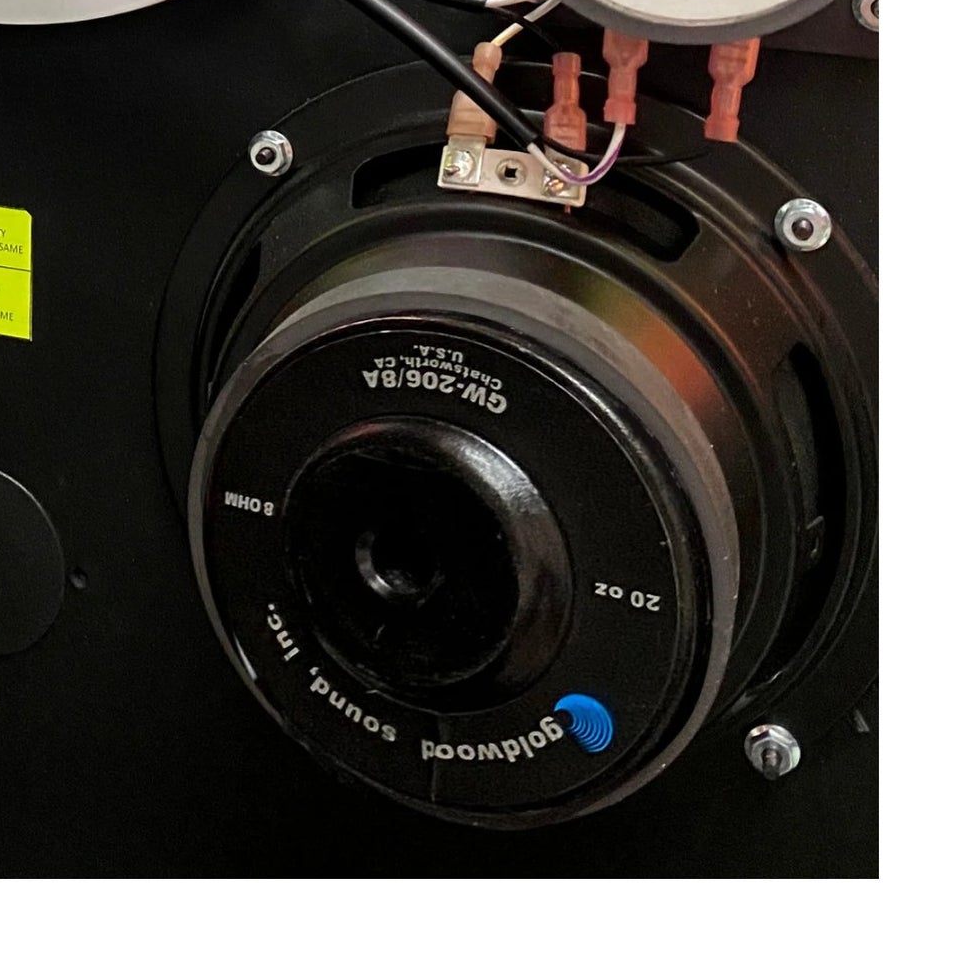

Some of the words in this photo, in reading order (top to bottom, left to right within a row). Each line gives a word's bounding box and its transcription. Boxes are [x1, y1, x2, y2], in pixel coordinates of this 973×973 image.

[0, 242, 23, 254] SAME
[374, 357, 396, 369] CA
[413, 345, 463, 362] U.S.A.
[400, 357, 502, 389] Chatsworth,
[362, 370, 507, 414] GW-206/8A
[225, 491, 260, 511] OHM
[263, 502, 274, 516] 8
[595, 583, 623, 600] oz
[631, 590, 660, 611] 20
[267, 603, 299, 660] inc.
[309, 666, 397, 743] sound,
[421, 716, 562, 761] goldwood
